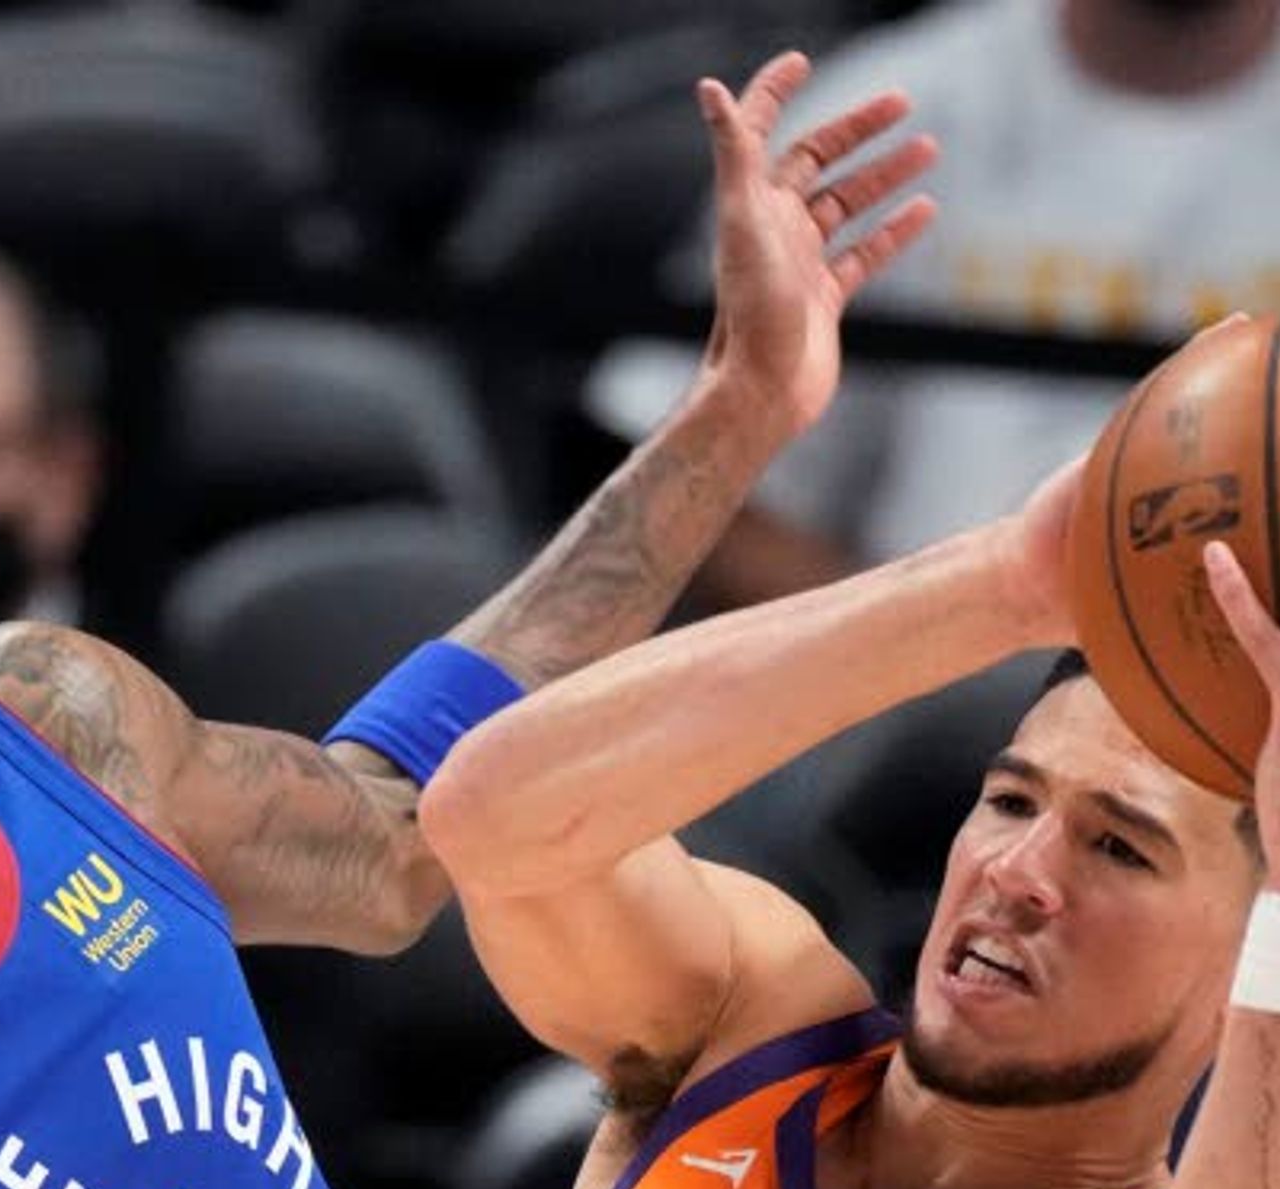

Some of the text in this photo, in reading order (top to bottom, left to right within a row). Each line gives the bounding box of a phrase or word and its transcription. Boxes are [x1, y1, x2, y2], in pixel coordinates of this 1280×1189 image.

[42, 852, 124, 936] WU
[81, 898, 149, 964] Western
[107, 924, 159, 972] Union
